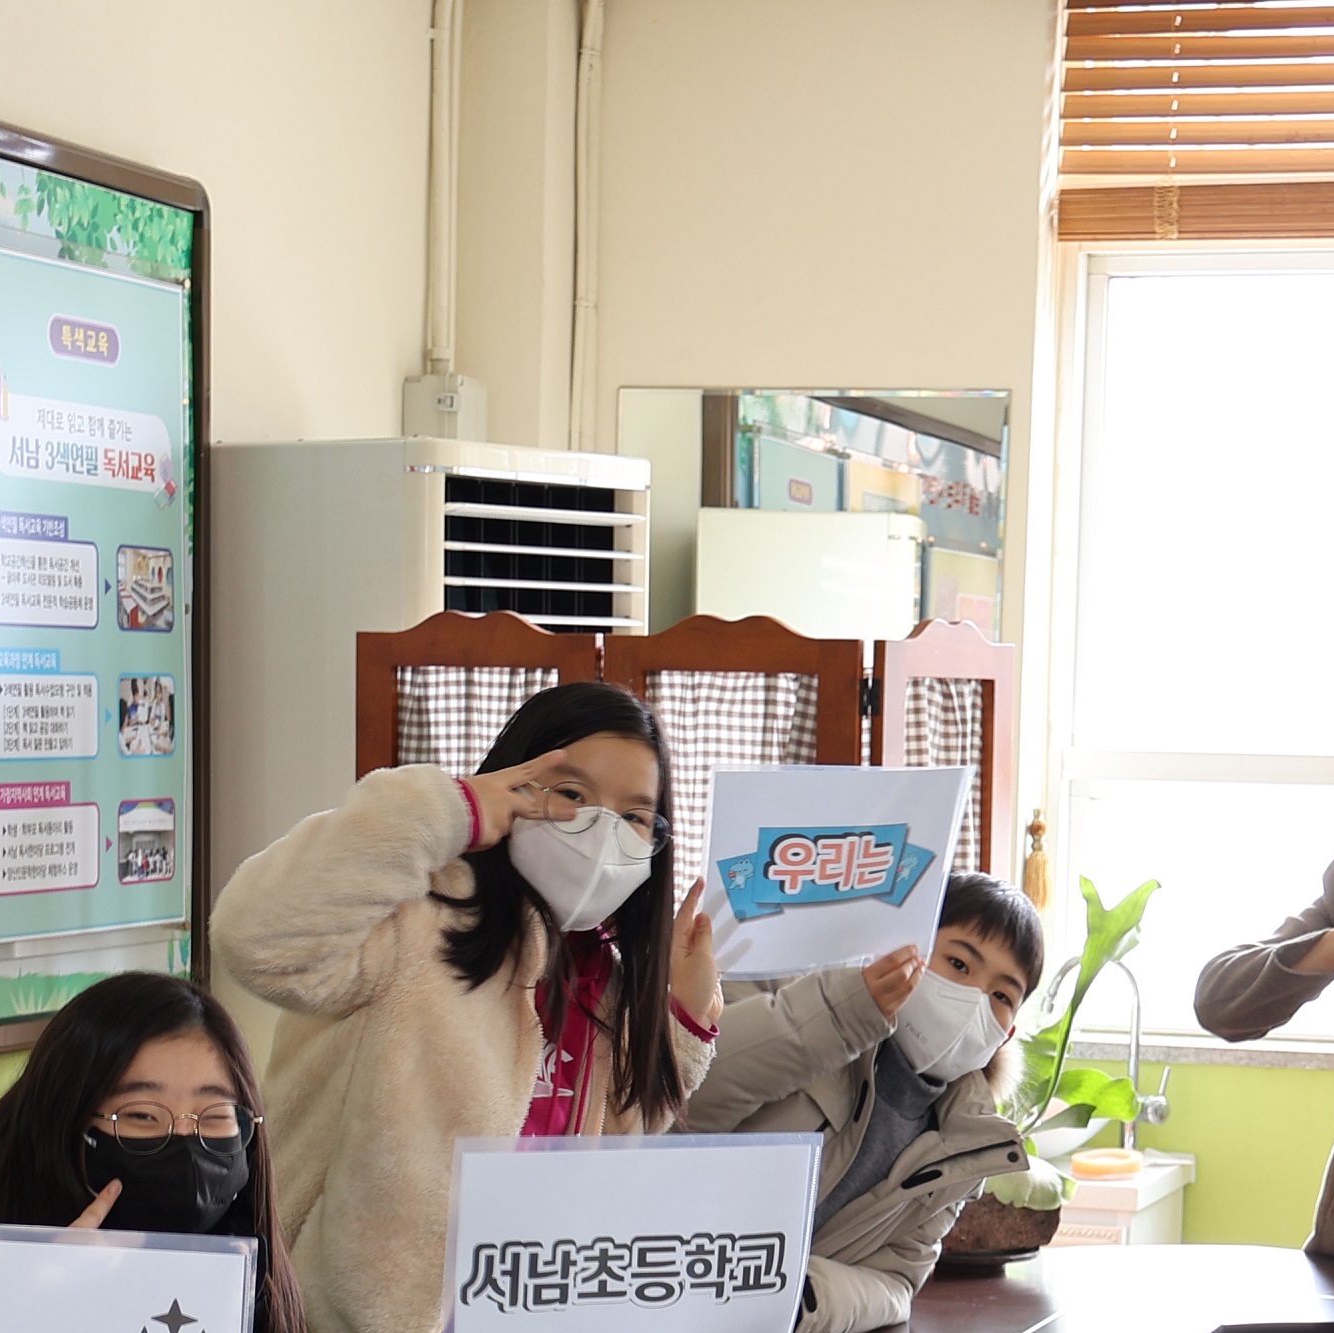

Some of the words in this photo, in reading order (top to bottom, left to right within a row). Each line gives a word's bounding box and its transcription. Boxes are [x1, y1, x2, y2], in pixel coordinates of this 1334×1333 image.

[61, 325, 110, 357] 특색교육
[8, 435, 41, 470] 서남
[45, 441, 100, 477] 3색연필
[103, 447, 156, 484] 독서교육
[765, 833, 894, 894] 우리는
[462, 1232, 787, 1313] 서남초등학교
